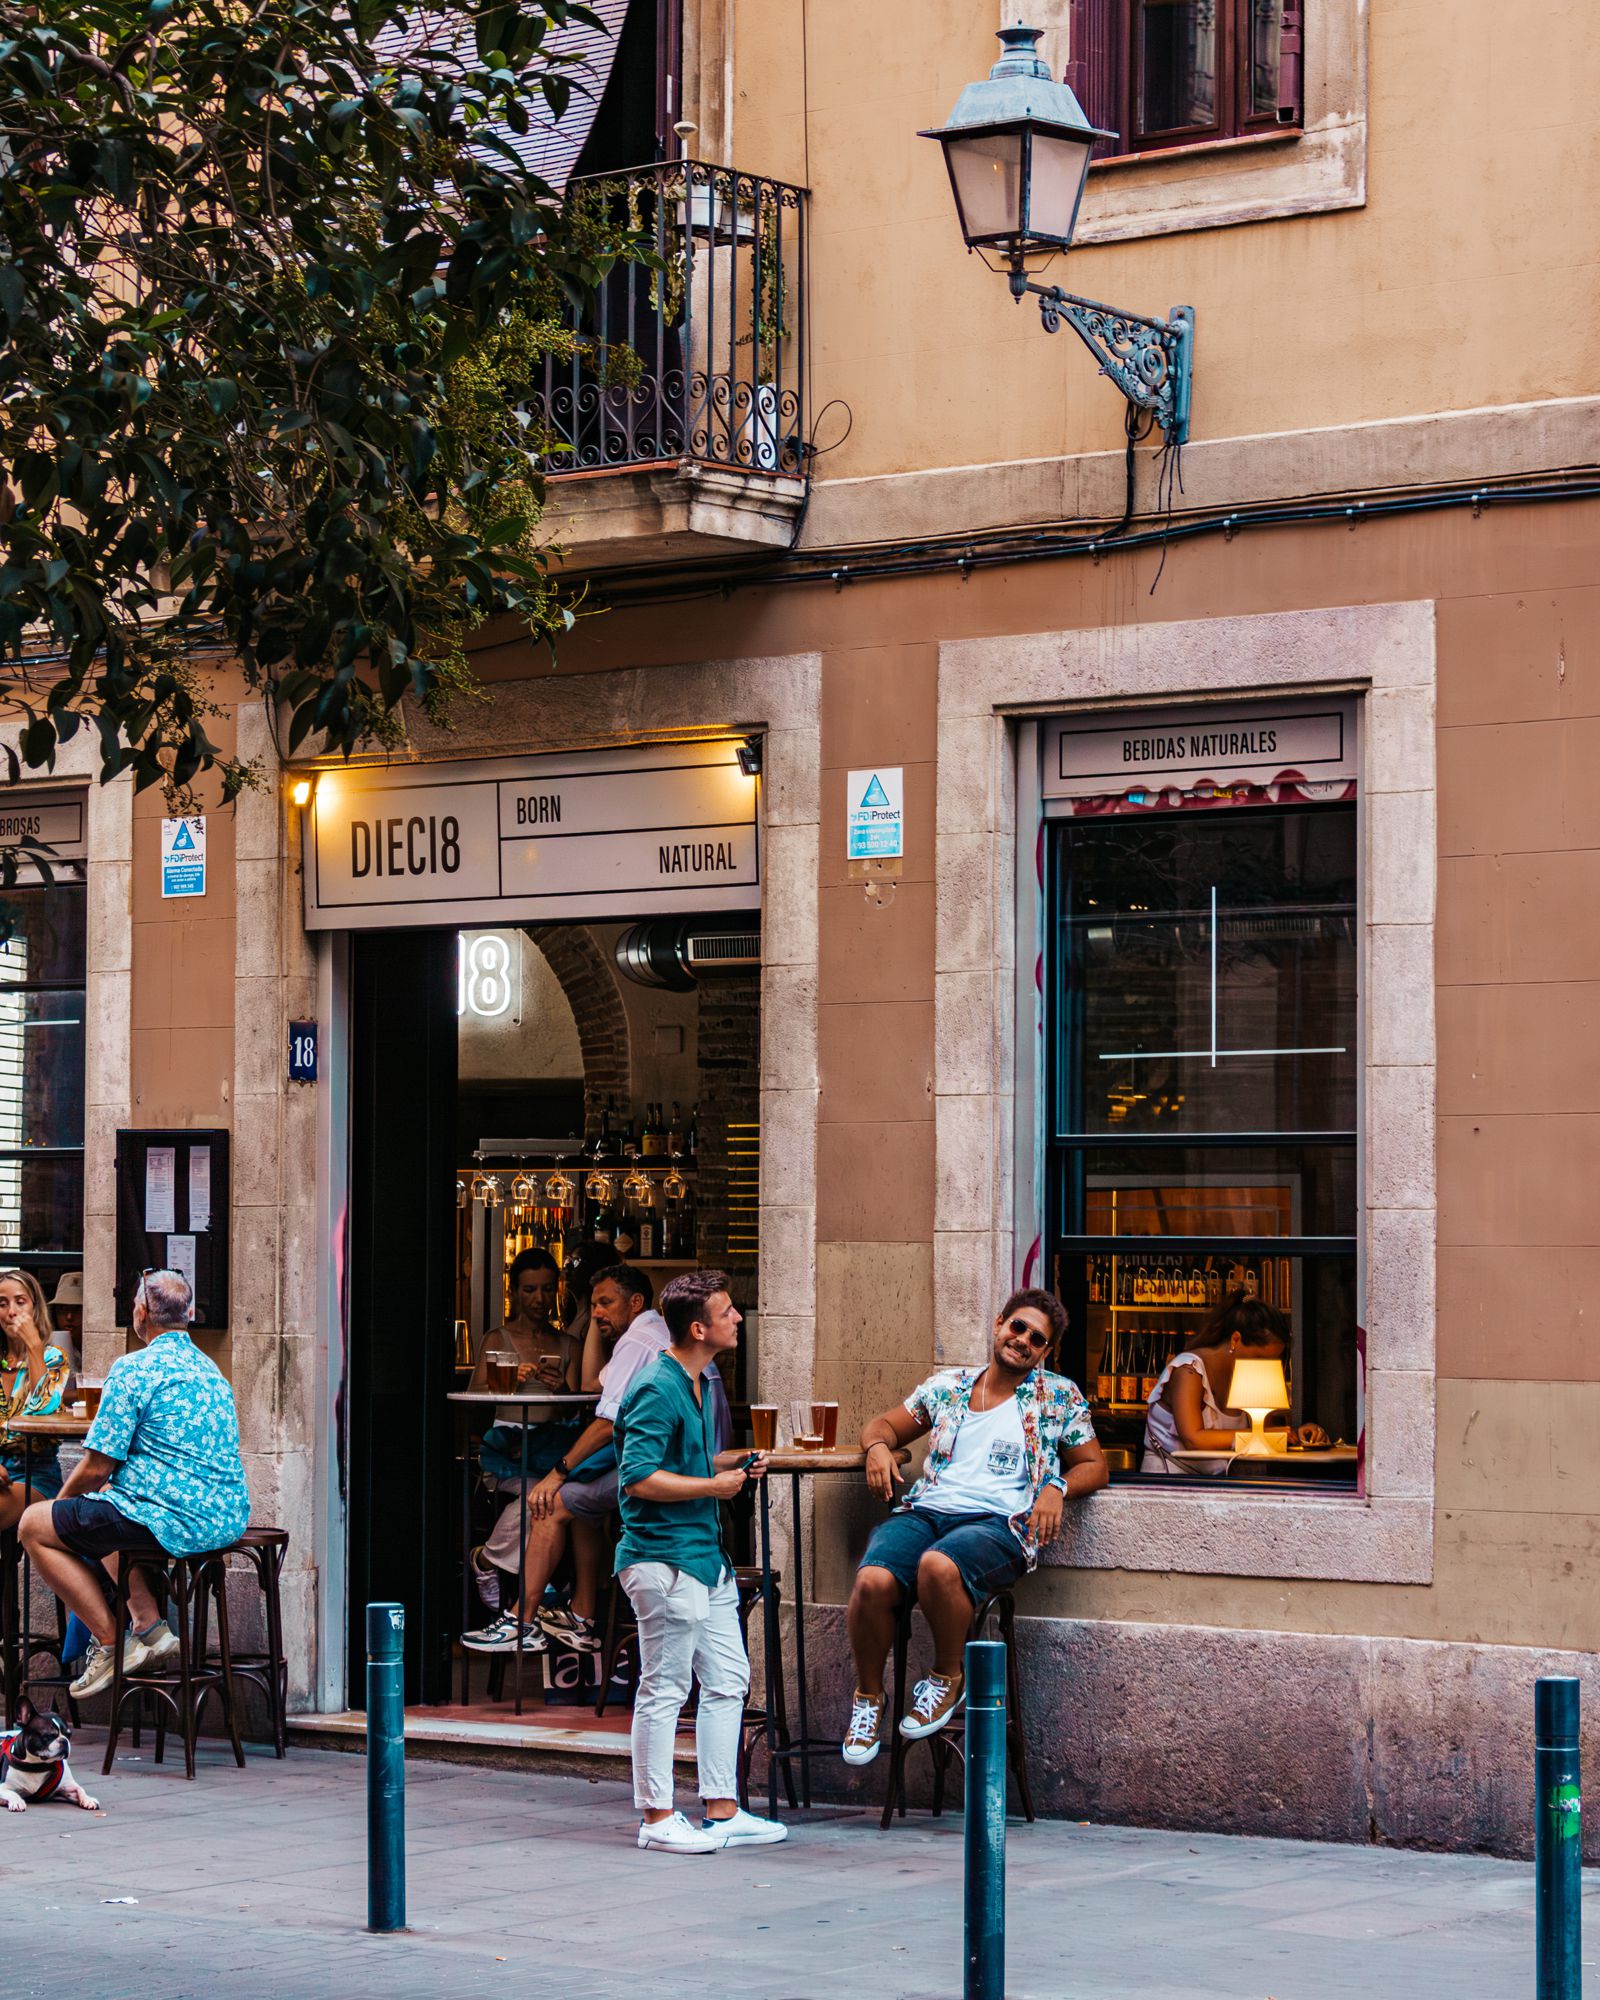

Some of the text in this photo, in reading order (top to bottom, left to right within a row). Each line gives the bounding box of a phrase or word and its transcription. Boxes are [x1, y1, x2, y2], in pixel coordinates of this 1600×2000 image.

[1123, 731, 1277, 761] BEBIDAS NATURALES
[516, 795, 561, 824] BORN
[351, 816, 461, 878] DIECI8
[659, 842, 737, 874] NATURAL
[294, 1036, 314, 1067] 18
